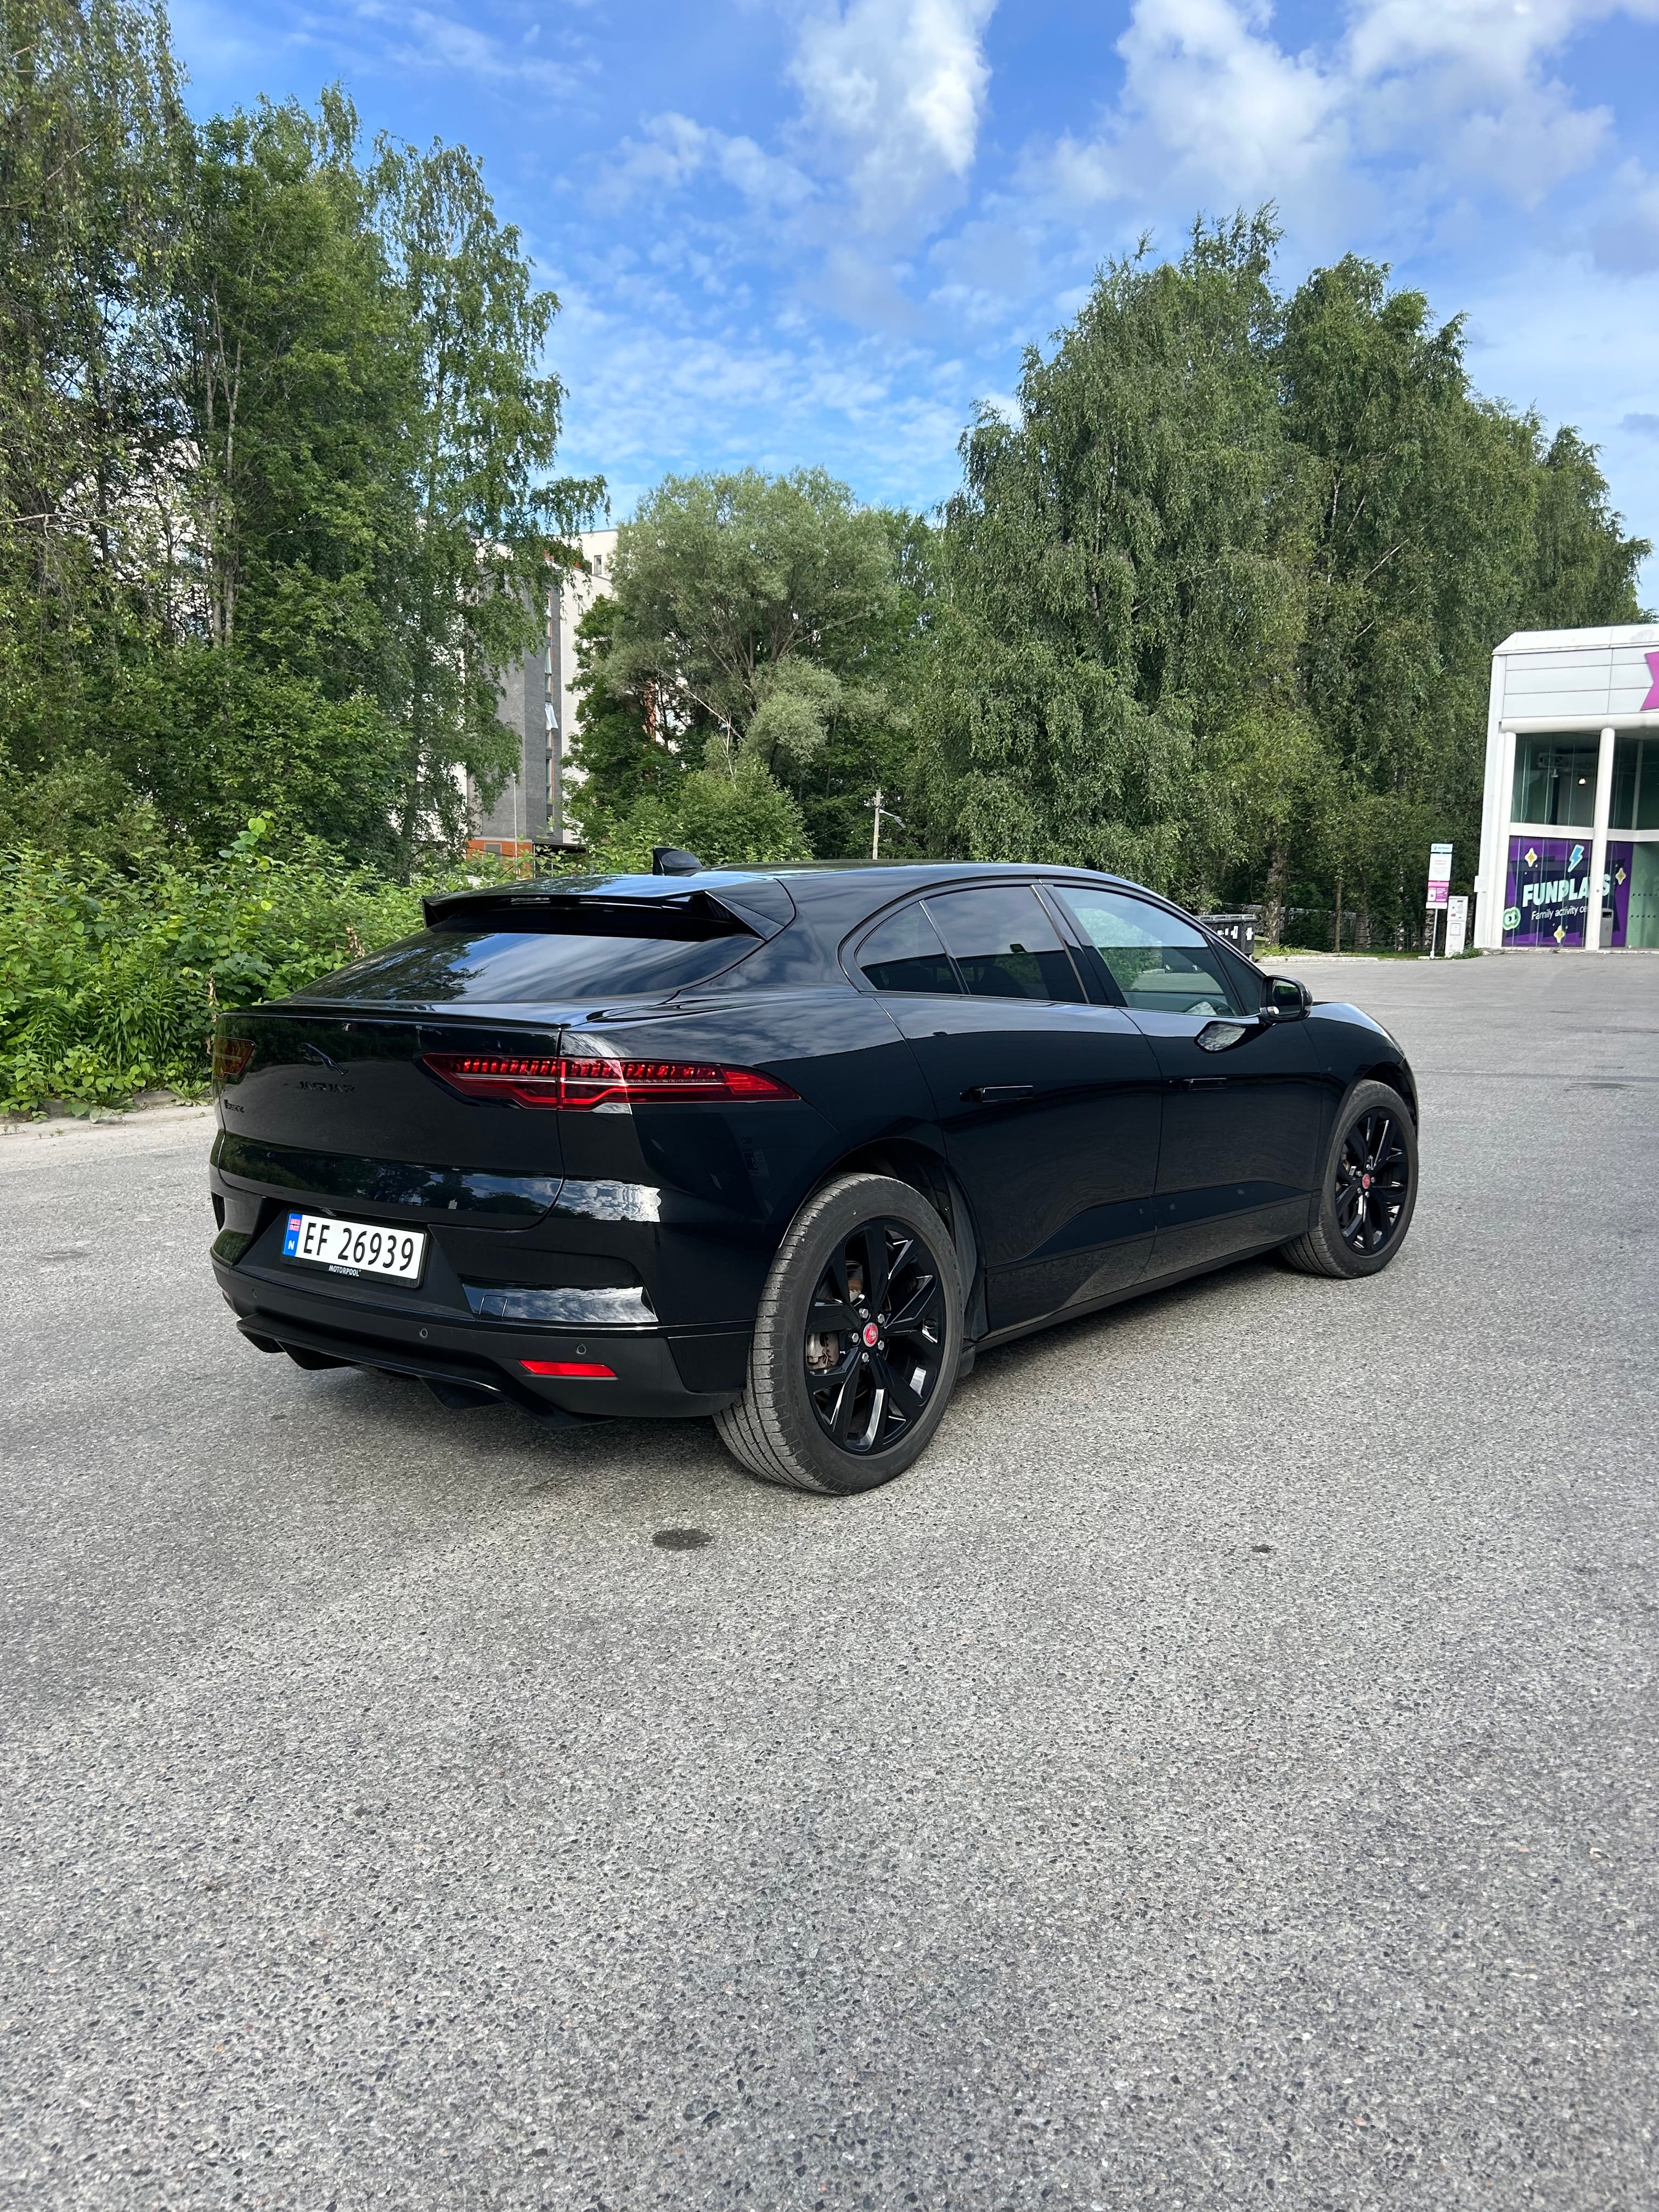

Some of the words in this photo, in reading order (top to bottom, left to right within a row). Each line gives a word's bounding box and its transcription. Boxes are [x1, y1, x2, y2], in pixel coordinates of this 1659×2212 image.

[1522, 874, 1610, 907] FUNPLAS
[1531, 909, 1554, 921] Family
[1555, 905, 1579, 916] activity
[287, 1240, 295, 1250] N
[303, 1222, 330, 1256] EF
[337, 1228, 414, 1271] 26939
